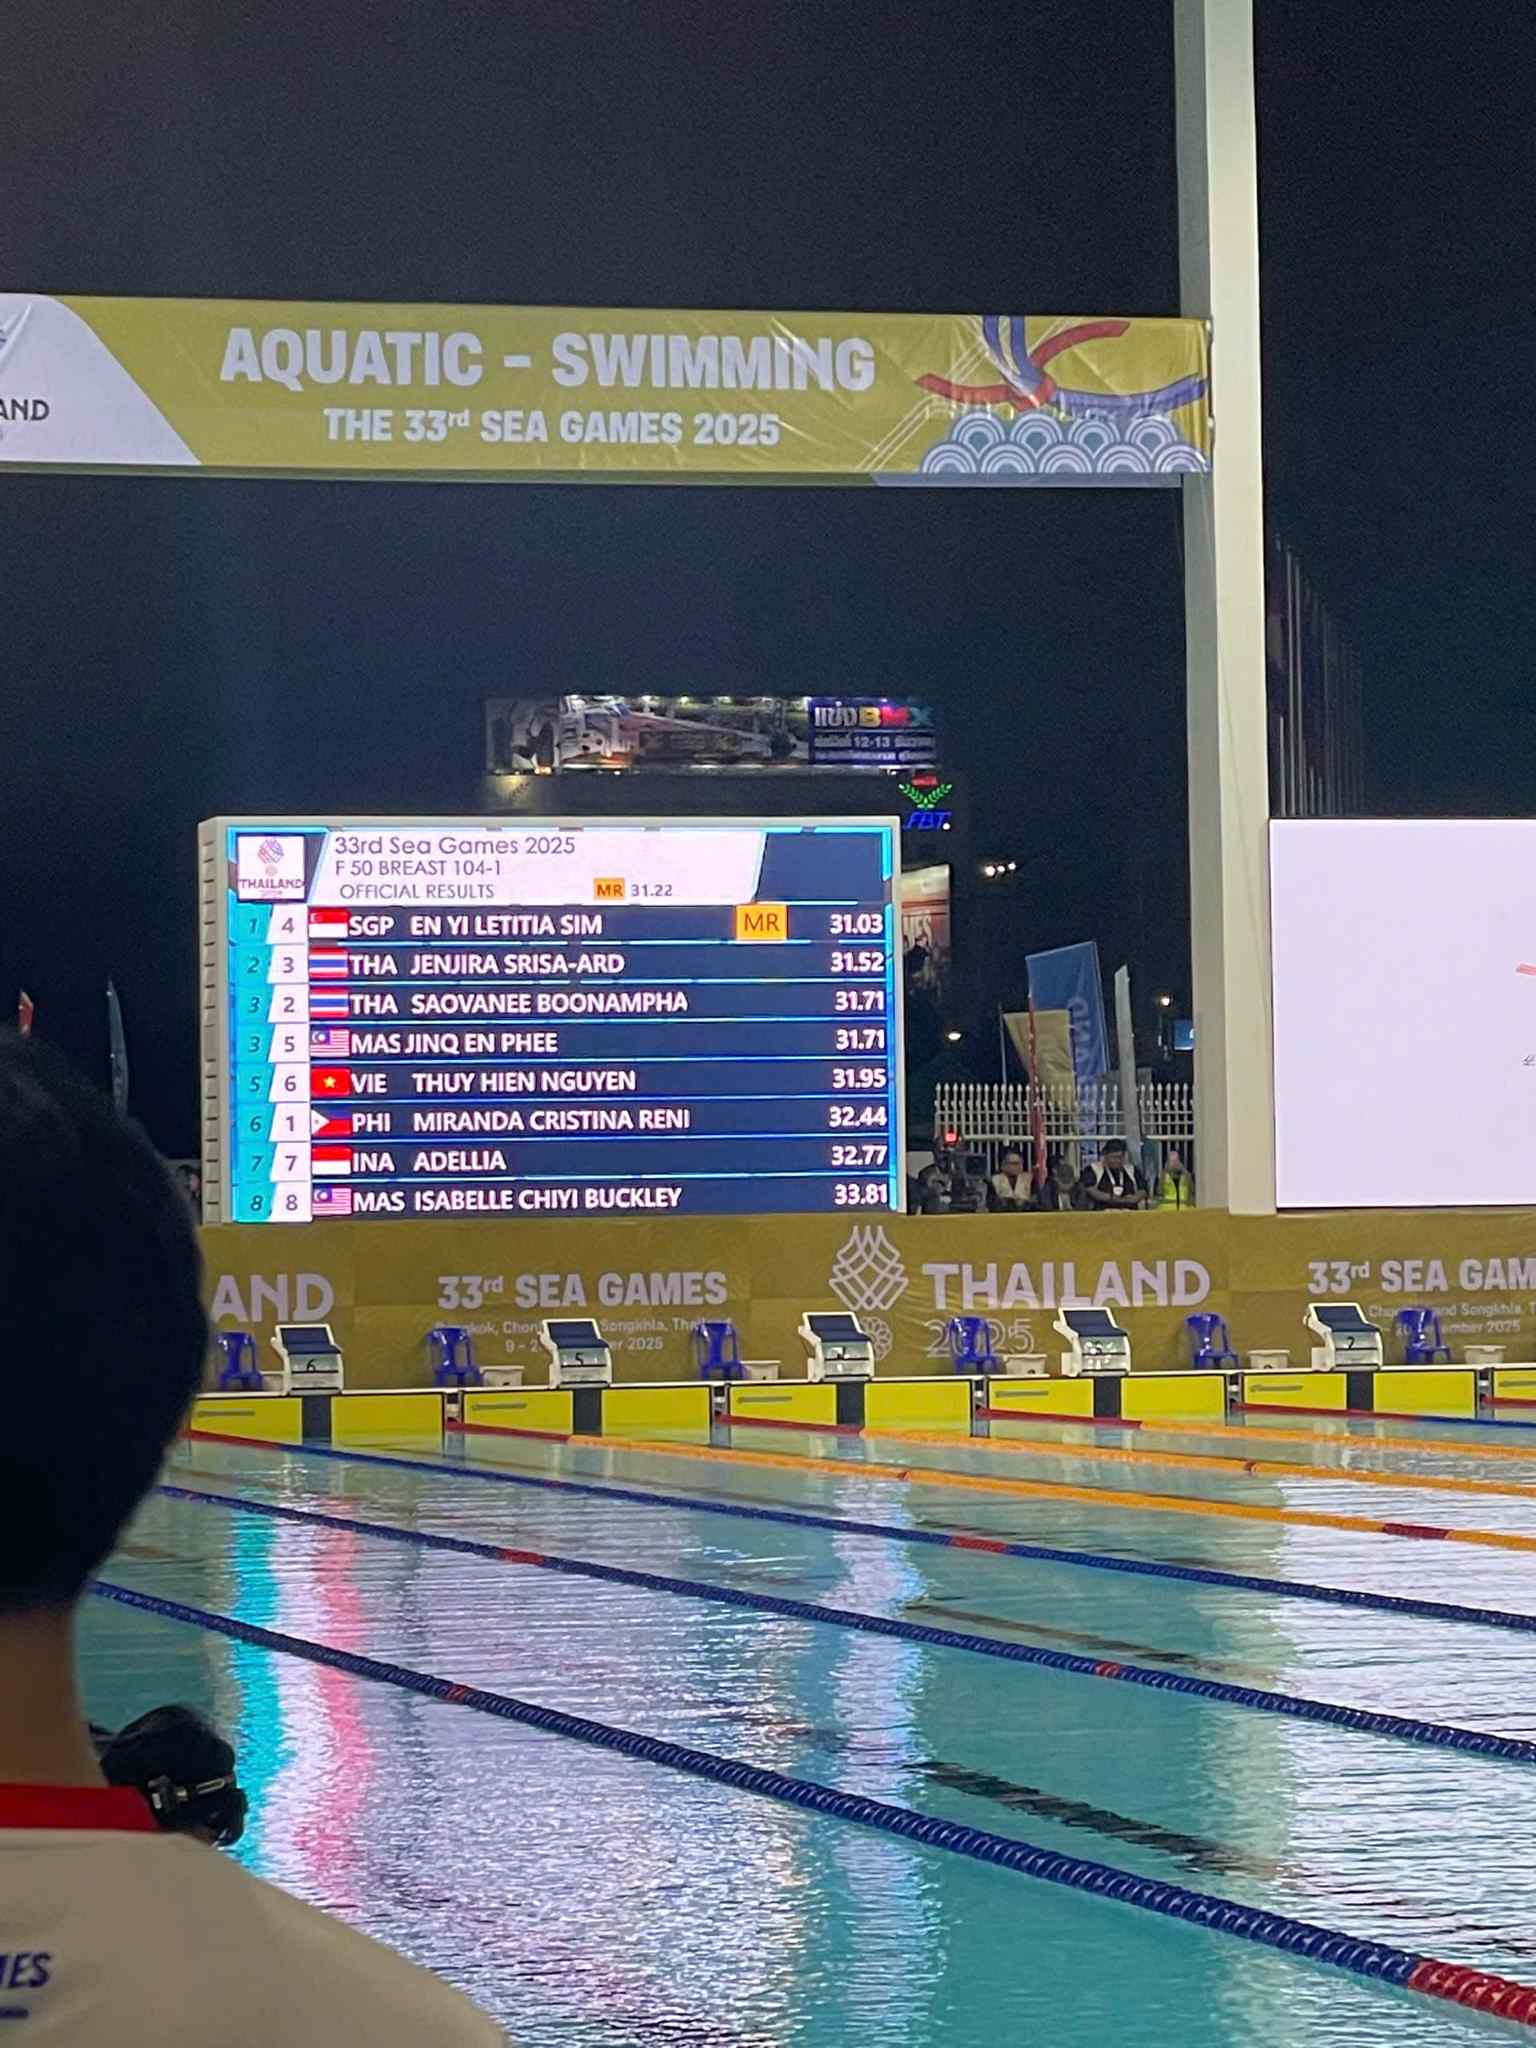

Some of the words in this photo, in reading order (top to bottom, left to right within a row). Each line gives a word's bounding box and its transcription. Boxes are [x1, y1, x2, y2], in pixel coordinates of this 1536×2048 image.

[219, 327, 484, 392] AQUATIC
[503, 355, 532, 368] -
[552, 332, 876, 391] SWIMMING
[323, 408, 393, 441] THE
[403, 408, 470, 442] 33rd
[480, 410, 548, 442] SEA
[559, 411, 683, 443] GAMES
[693, 413, 779, 445] 2025
[335, 837, 382, 854] 33rd
[389, 837, 431, 855] Sea
[438, 837, 519, 855] Games
[525, 837, 576, 855] 2025
[335, 860, 345, 876] F
[350, 860, 373, 876] 50
[378, 860, 447, 876] BREAST
[454, 860, 501, 876] 104-1
[340, 884, 419, 899] OFFICIAL
[426, 884, 495, 899] RESULTS
[596, 884, 623, 897] MR
[632, 885, 673, 897] 31.22
[249, 918, 259, 934] 1
[281, 917, 296, 933] 4
[350, 916, 395, 936] SGP
[411, 916, 441, 936] EN
[447, 916, 469, 935] YI
[475, 915, 556, 935] LETITIA
[560, 915, 602, 935] SIM
[744, 912, 780, 933] MR
[830, 914, 884, 934] 31.03
[247, 957, 260, 974] 2
[282, 956, 295, 974] 3
[350, 954, 398, 975] THA
[410, 954, 499, 976] JENJIRA
[503, 953, 625, 974] SRISA-ARD
[830, 951, 885, 972] 31.52
[248, 996, 260, 1014] 3
[283, 996, 295, 1013] 2
[350, 994, 399, 1015] THA
[411, 994, 531, 1014] SAOVANEE
[537, 992, 688, 1013] BOONAMPHA
[834, 990, 886, 1011] 31.71
[249, 1035, 261, 1053] 3
[284, 1035, 296, 1052] 5
[352, 1034, 401, 1054] MAS
[404, 1033, 460, 1055] JINQ
[464, 1033, 496, 1053] EN
[501, 1033, 558, 1053] PHEE
[836, 1029, 886, 1050] 31.71
[249, 1075, 261, 1093] 5
[284, 1074, 297, 1092] 6
[351, 1073, 388, 1093] VIE
[412, 1072, 475, 1093] THUY
[480, 1072, 536, 1092] HIEN
[541, 1070, 636, 1091] NGUYEN
[832, 1068, 887, 1089] 31.95
[250, 1115, 262, 1132] 6
[287, 1115, 296, 1132] 1
[352, 1113, 391, 1133] PHI
[413, 1111, 524, 1132] MIRANDA
[529, 1110, 634, 1131] CRISTINA
[639, 1109, 691, 1129] RENI
[829, 1106, 888, 1128] 32.44
[250, 1155, 263, 1172] 7
[285, 1155, 298, 1172] 7
[352, 1152, 395, 1173] INA
[413, 1150, 507, 1172] ADELLIA
[831, 1145, 888, 1166] 32.77
[250, 1194, 264, 1212] 8
[286, 1194, 298, 1212] 8
[354, 1191, 406, 1212] MAS
[415, 1189, 513, 1212] ISABELLE
[518, 1188, 579, 1210] CHIYI
[585, 1186, 682, 1209] BUCKLEY
[834, 1183, 888, 1205] 33.81
[921, 1260, 1212, 1311] THAILAND
[1307, 1260, 1370, 1295] 33rd
[1380, 1259, 1449, 1292] SEA
[1459, 1257, 1536, 1291] GAM
[210, 1273, 335, 1323] AND
[437, 1275, 504, 1310] 33rd
[514, 1273, 588, 1308] SEA
[597, 1271, 728, 1306] GAMES
